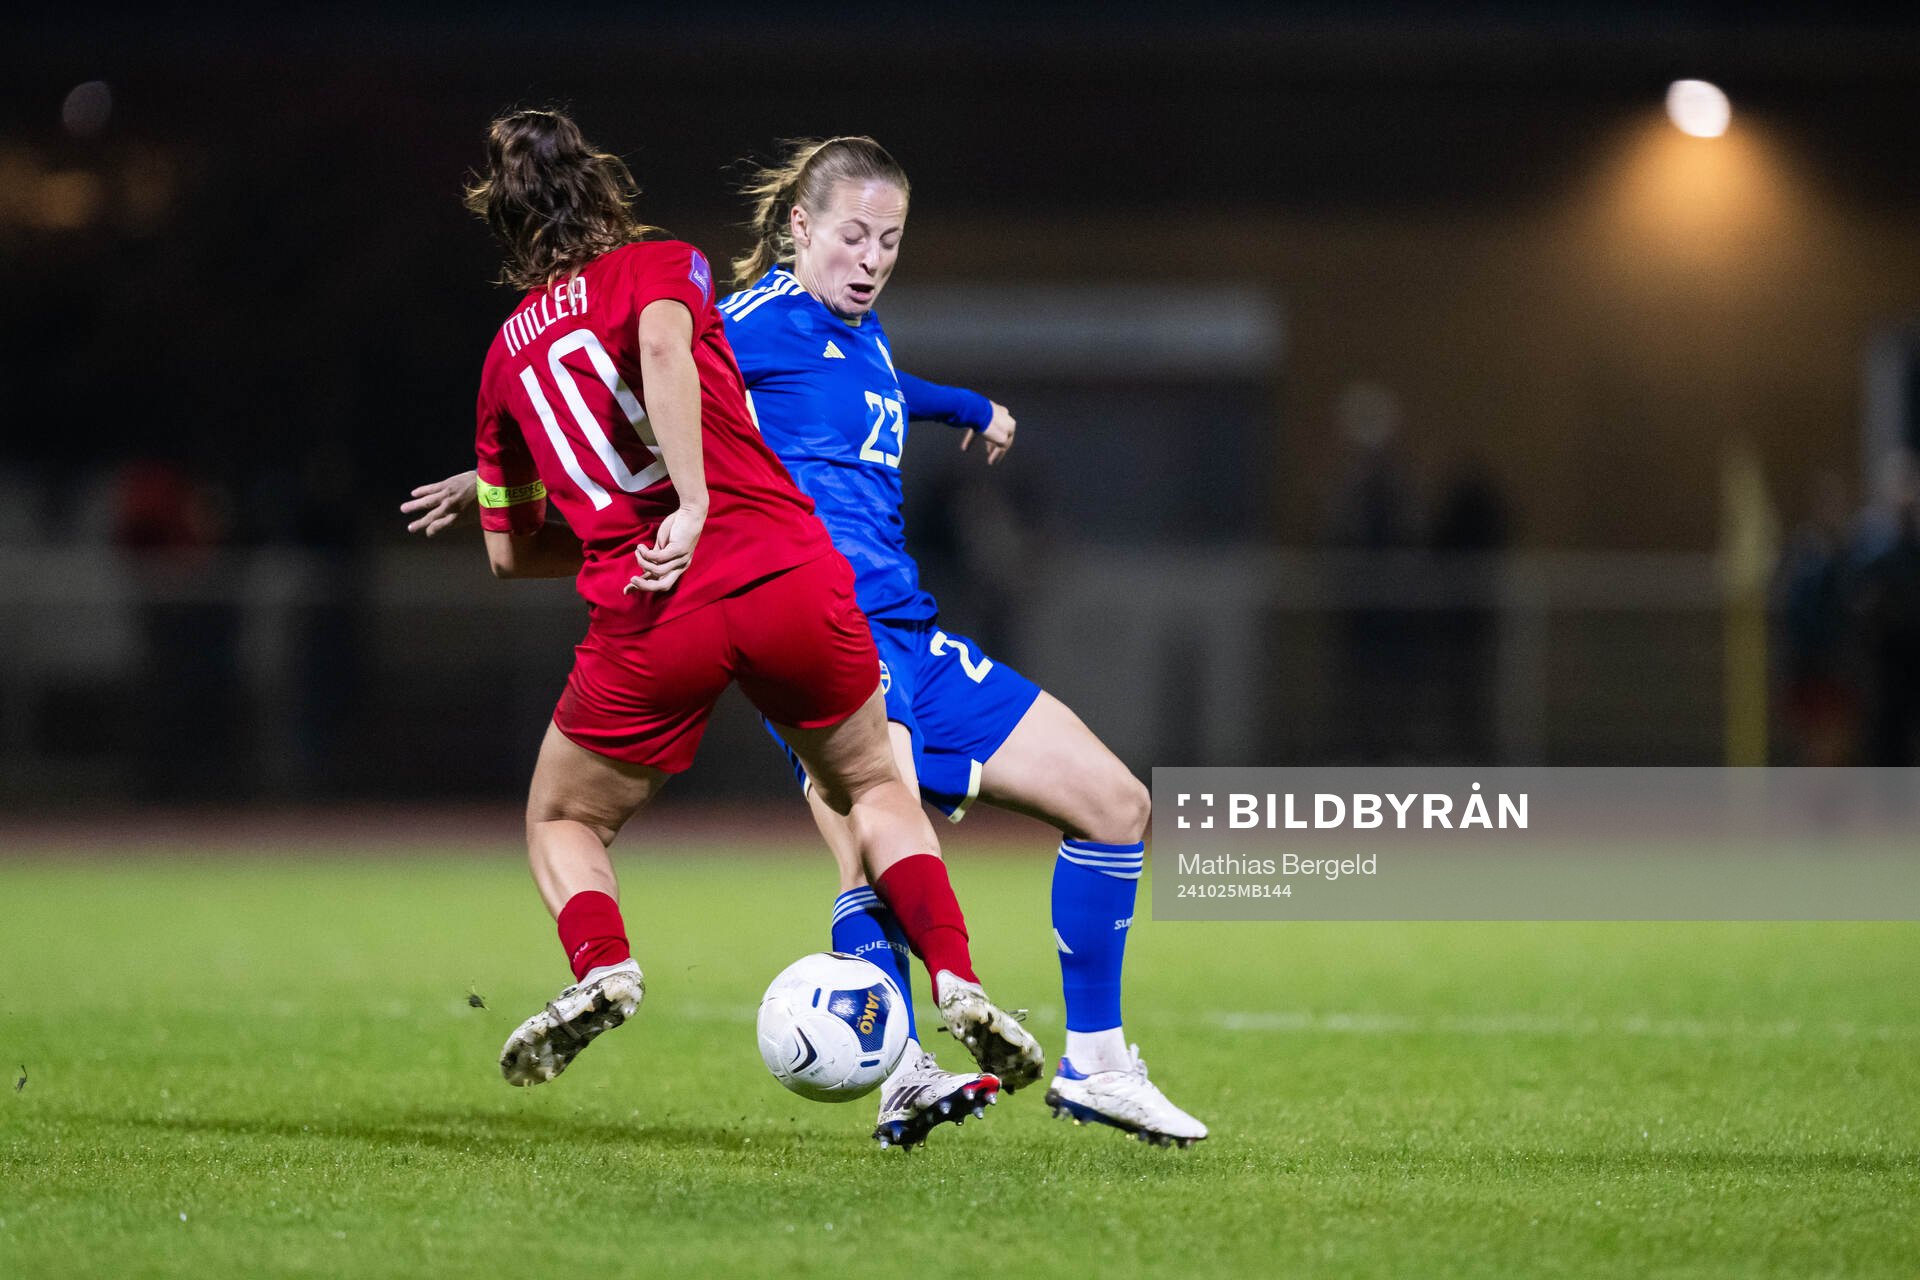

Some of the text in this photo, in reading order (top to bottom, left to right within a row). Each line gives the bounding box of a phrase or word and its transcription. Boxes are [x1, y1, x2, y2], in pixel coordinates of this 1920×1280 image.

[503, 276, 588, 357] MILLER
[519, 329, 669, 511] 10
[859, 390, 904, 469] 23
[930, 631, 994, 684] 2
[860, 990, 881, 1035] JAKO
